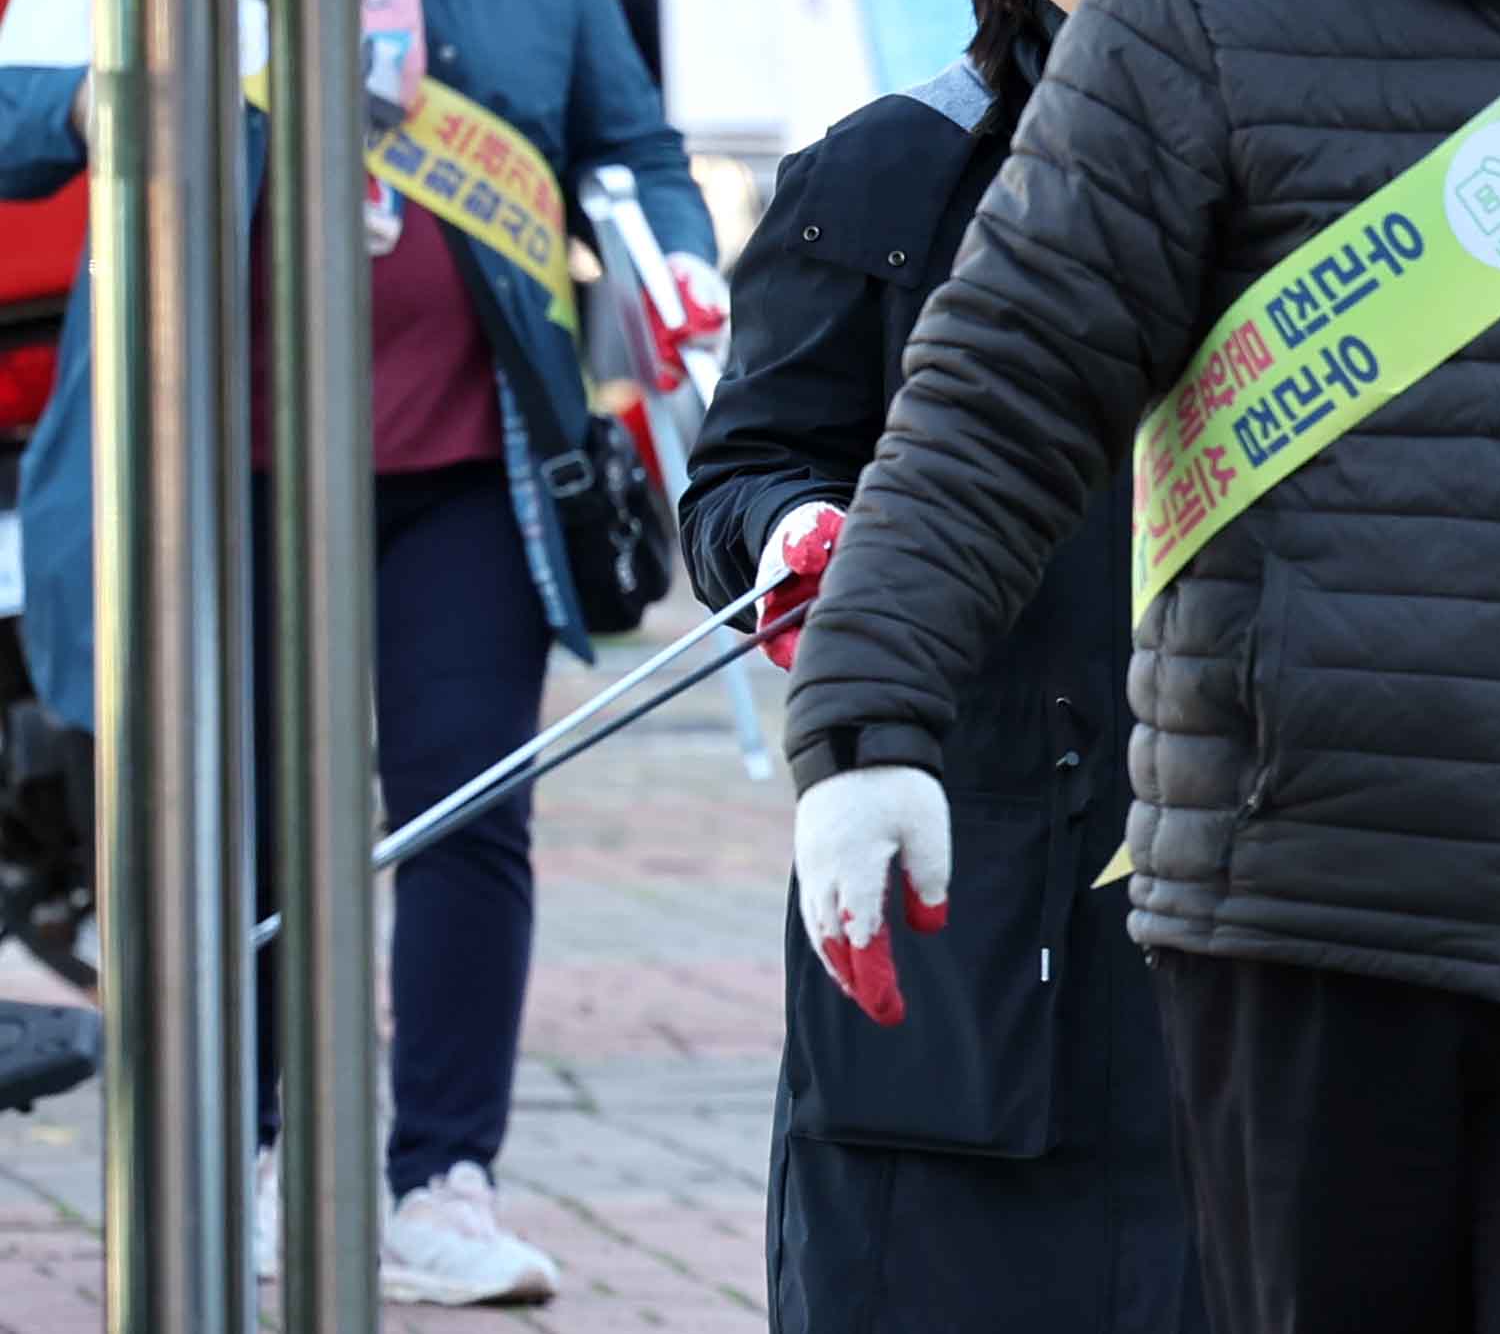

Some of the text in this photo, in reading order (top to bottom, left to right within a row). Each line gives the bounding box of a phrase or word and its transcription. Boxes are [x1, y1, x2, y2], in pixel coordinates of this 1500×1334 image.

[1266, 212, 1424, 349] 우리집
[1176, 320, 1274, 448] 문앞에
[1140, 335, 1379, 592] 우리집 쓰레기
